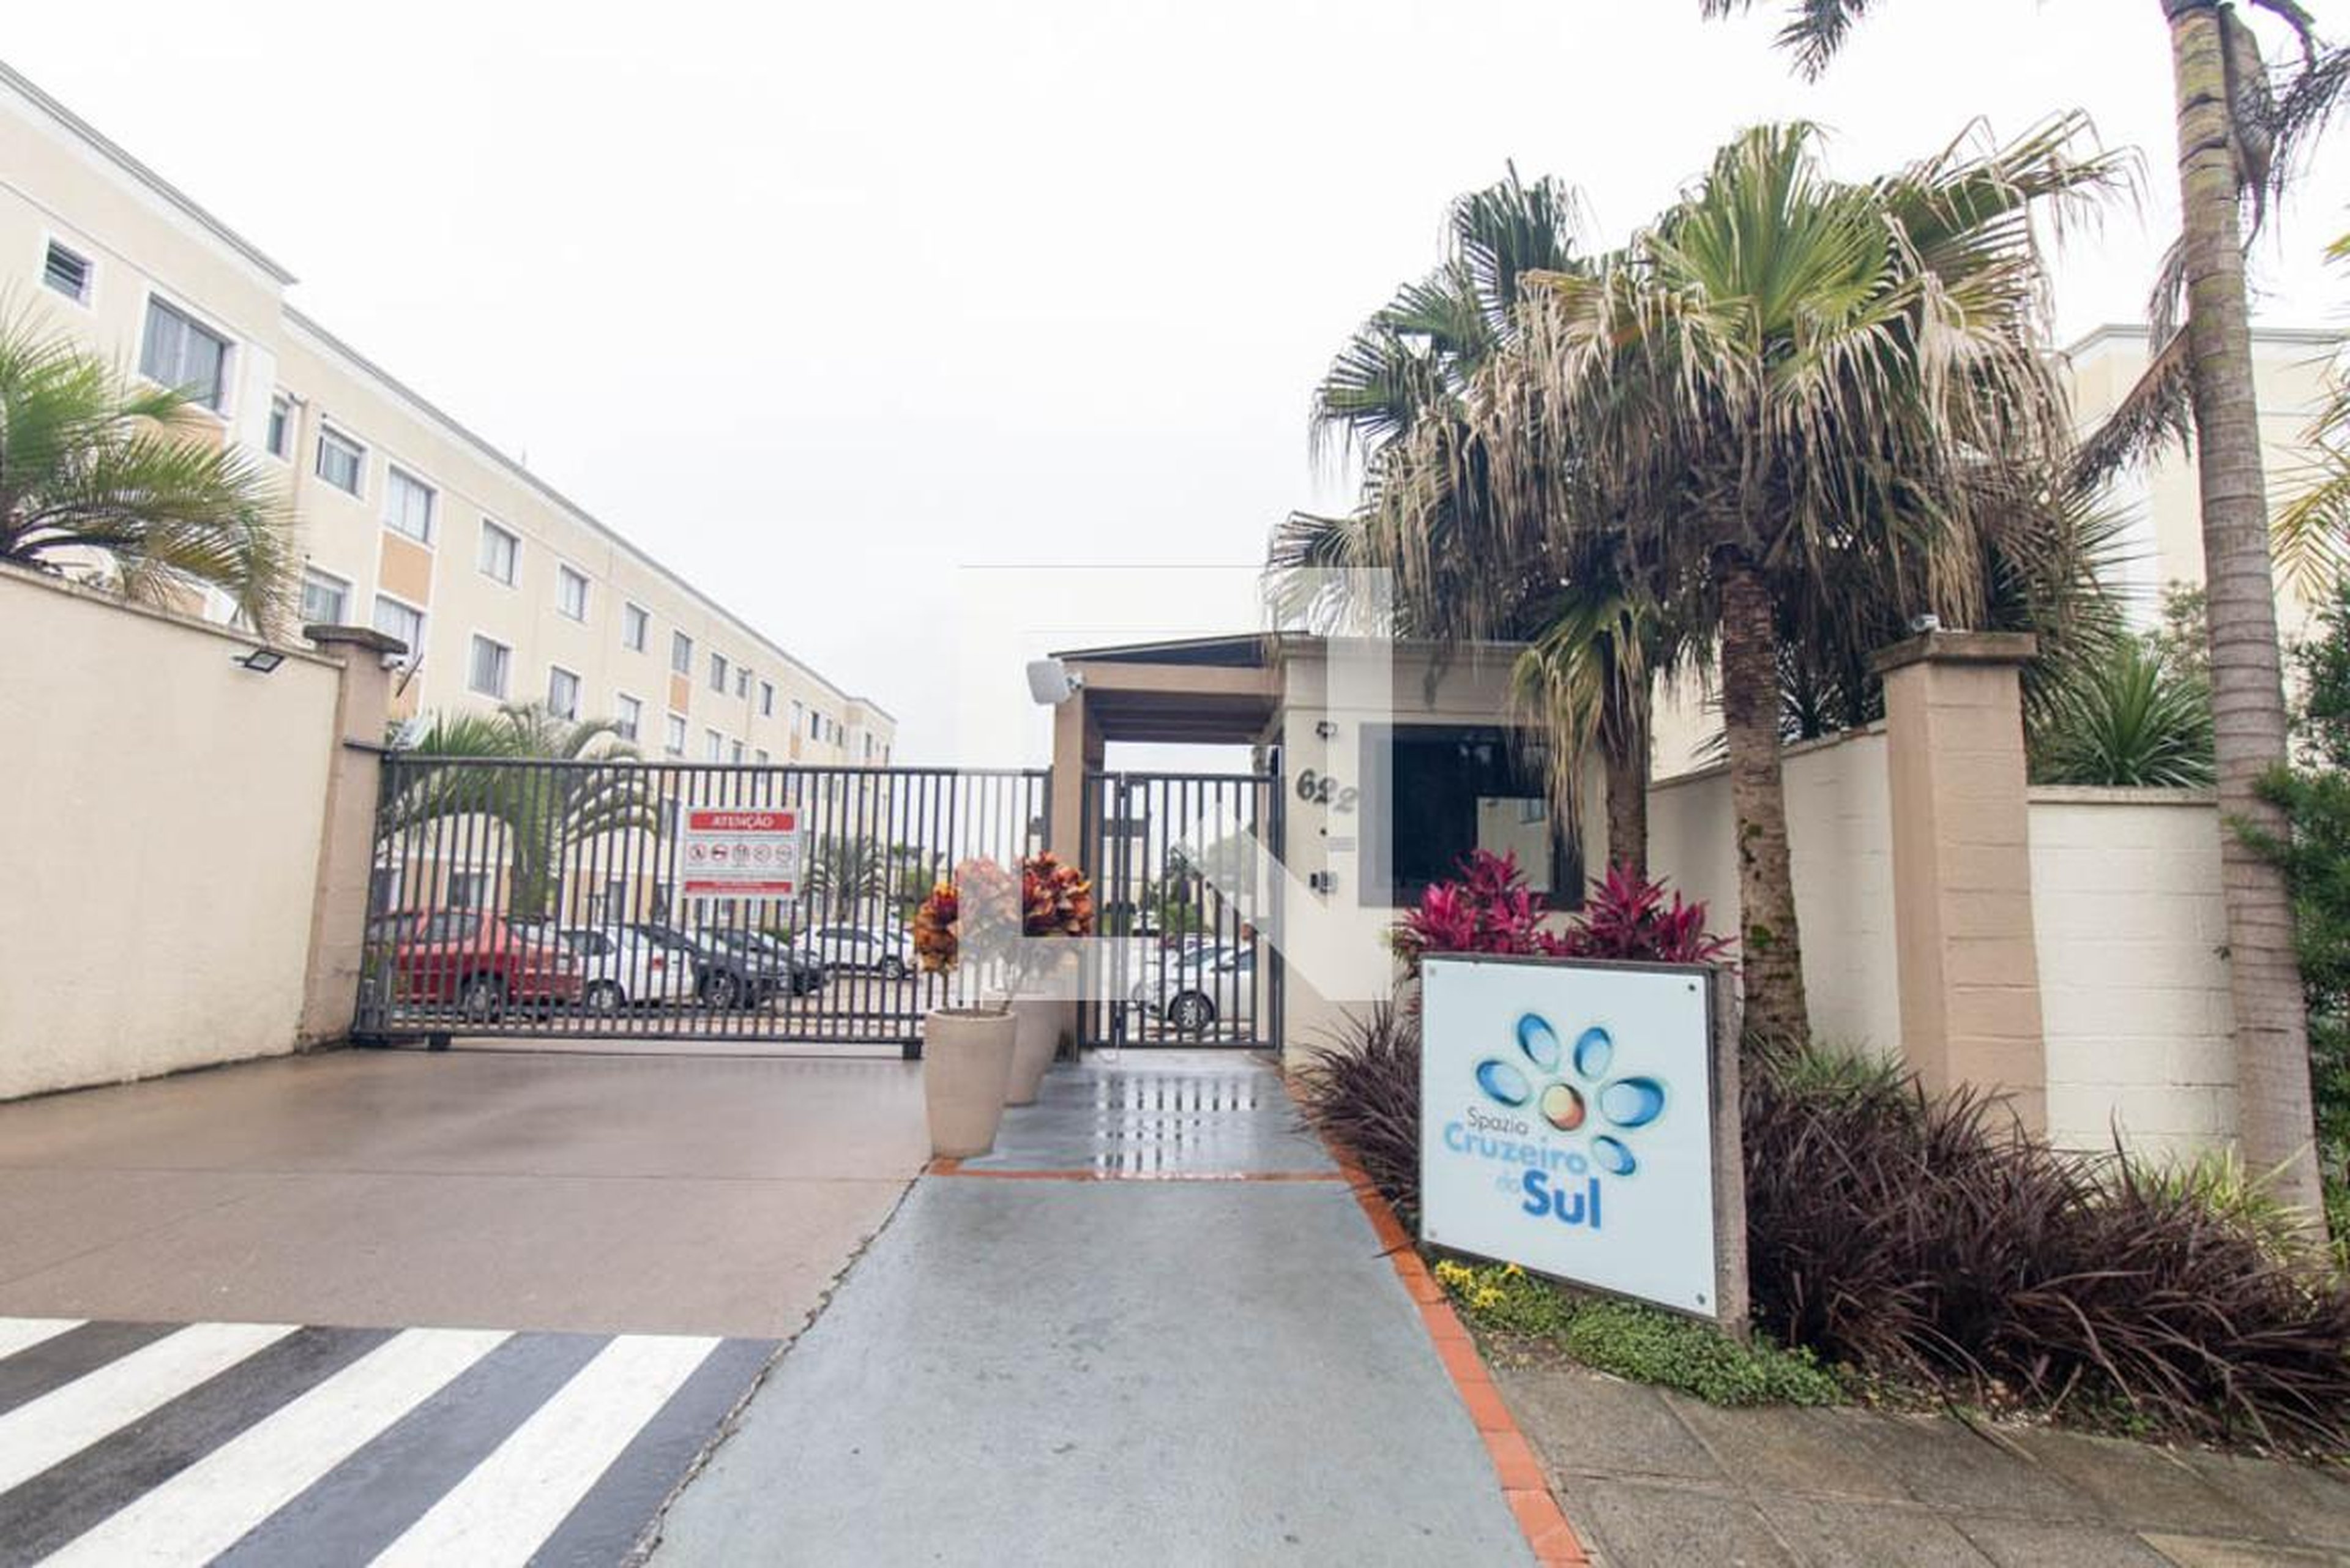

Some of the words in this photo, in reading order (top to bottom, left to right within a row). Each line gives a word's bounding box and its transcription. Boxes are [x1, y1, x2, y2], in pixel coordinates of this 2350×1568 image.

[1296, 768, 1357, 812] 622
[712, 813, 775, 828] ATENÇÃO
[1468, 1106, 1528, 1135] Spazio
[1444, 1121, 1587, 1175] Cruzeiro
[1522, 1170, 1601, 1228] Sul
